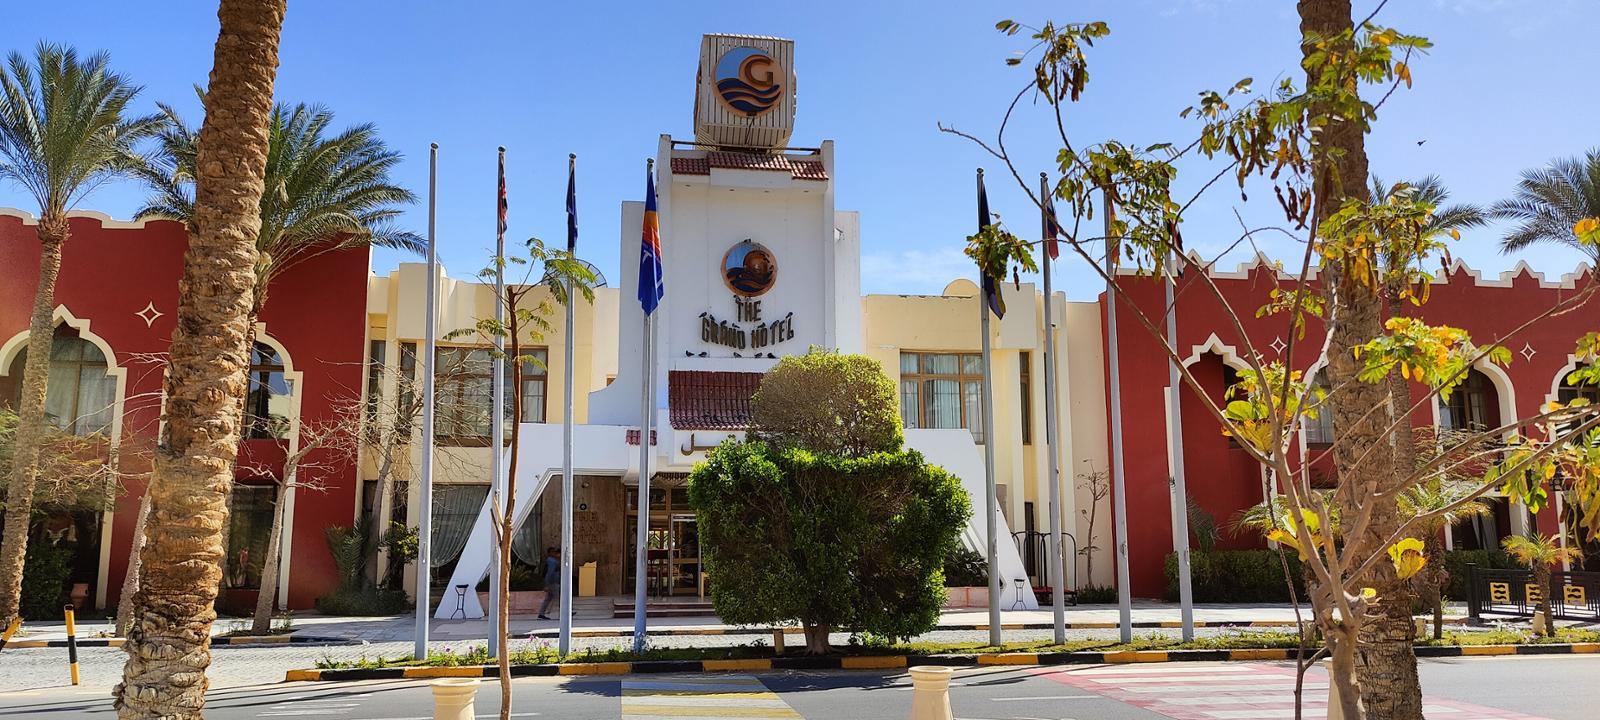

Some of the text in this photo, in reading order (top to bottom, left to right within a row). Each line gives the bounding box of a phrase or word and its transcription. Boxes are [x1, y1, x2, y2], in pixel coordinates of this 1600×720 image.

[744, 57, 774, 87] G
[735, 300, 762, 323] THE
[701, 317, 795, 350] GRAND HOTEL
